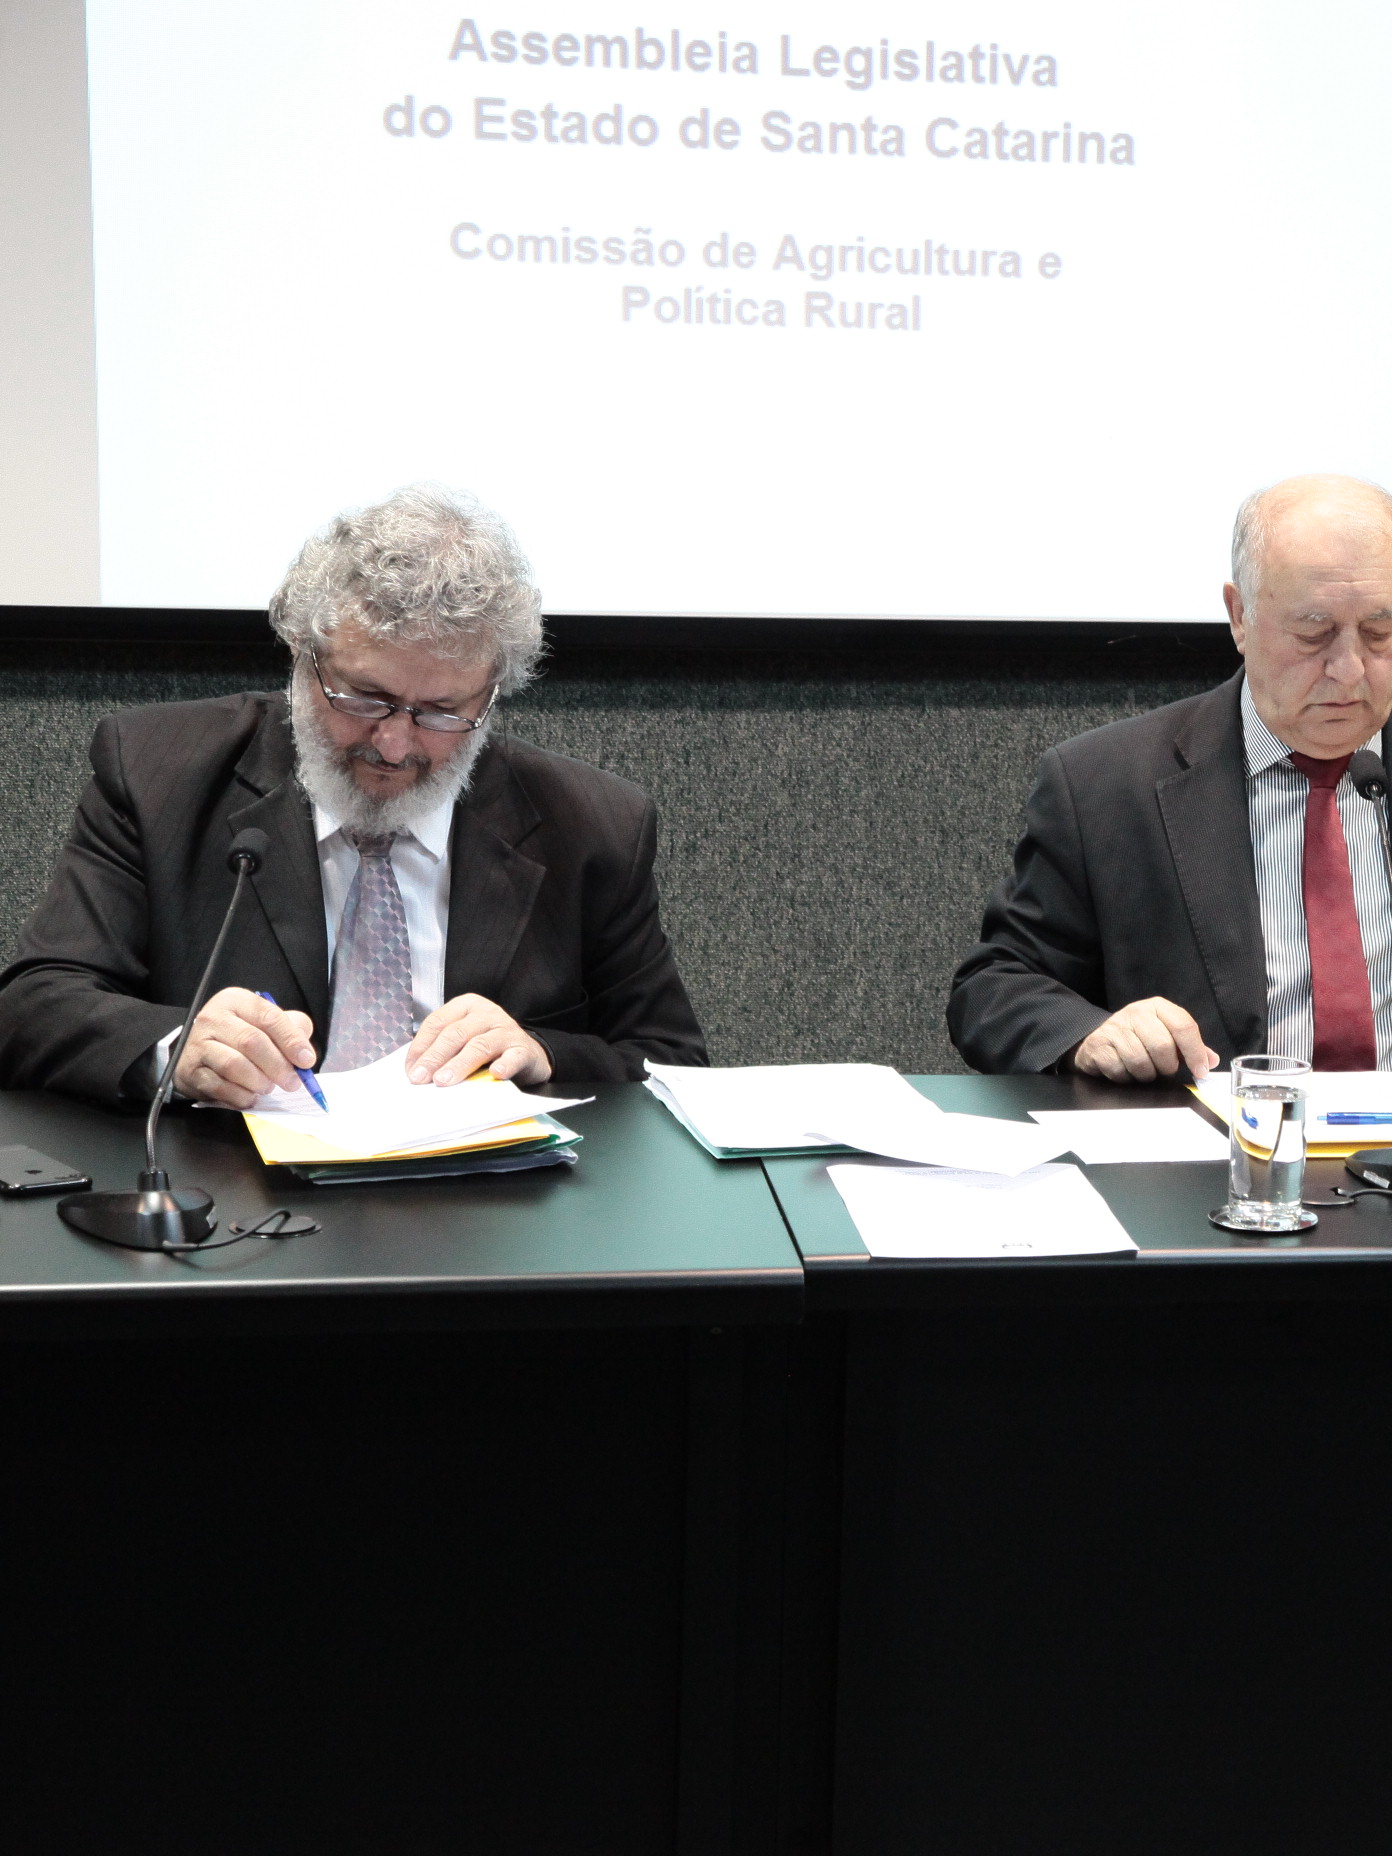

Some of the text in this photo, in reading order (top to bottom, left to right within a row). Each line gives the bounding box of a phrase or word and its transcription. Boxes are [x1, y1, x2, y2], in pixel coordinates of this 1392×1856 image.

[449, 19, 1057, 91] Assembleia Legislativa
[383, 95, 1134, 165] do Estado de Santa Catarina
[450, 223, 1061, 281] Comissão de Agricultura e
[623, 286, 920, 330] Política Rural
